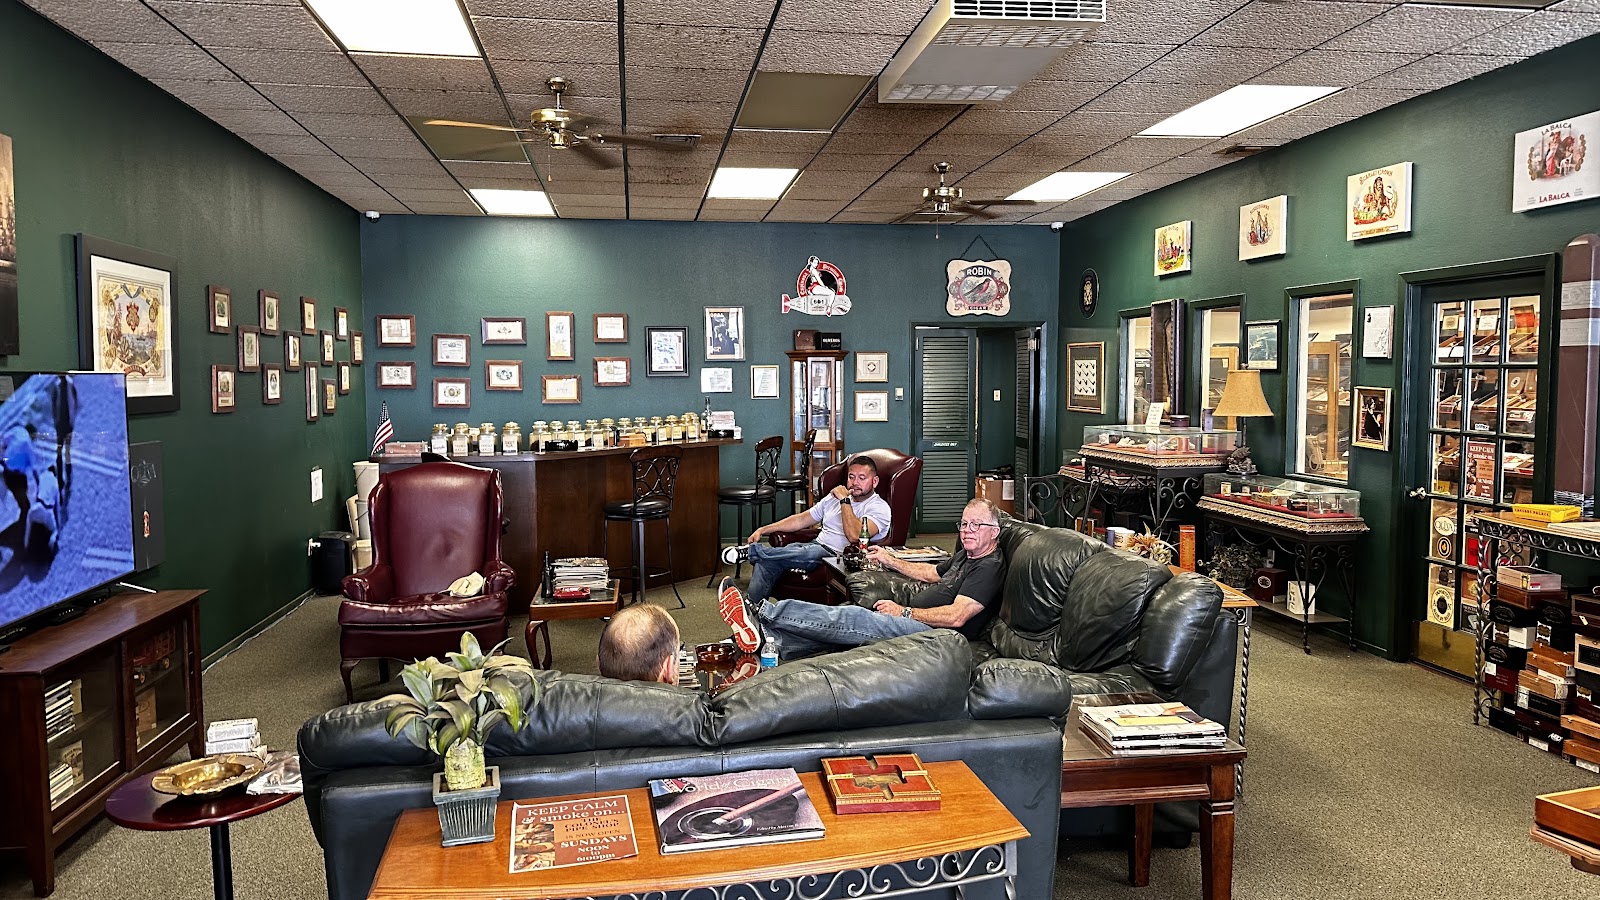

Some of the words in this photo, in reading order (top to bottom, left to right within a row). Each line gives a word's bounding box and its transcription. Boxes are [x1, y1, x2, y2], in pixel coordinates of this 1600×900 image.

[966, 267, 992, 276] ROBIN
[733, 776, 792, 789] Cigars
[527, 805, 569, 817] KEEP
[572, 800, 618, 812] CALM
[539, 811, 590, 822] smoke
[560, 835, 628, 849] SUNDAYS
[578, 844, 610, 853] NOON
